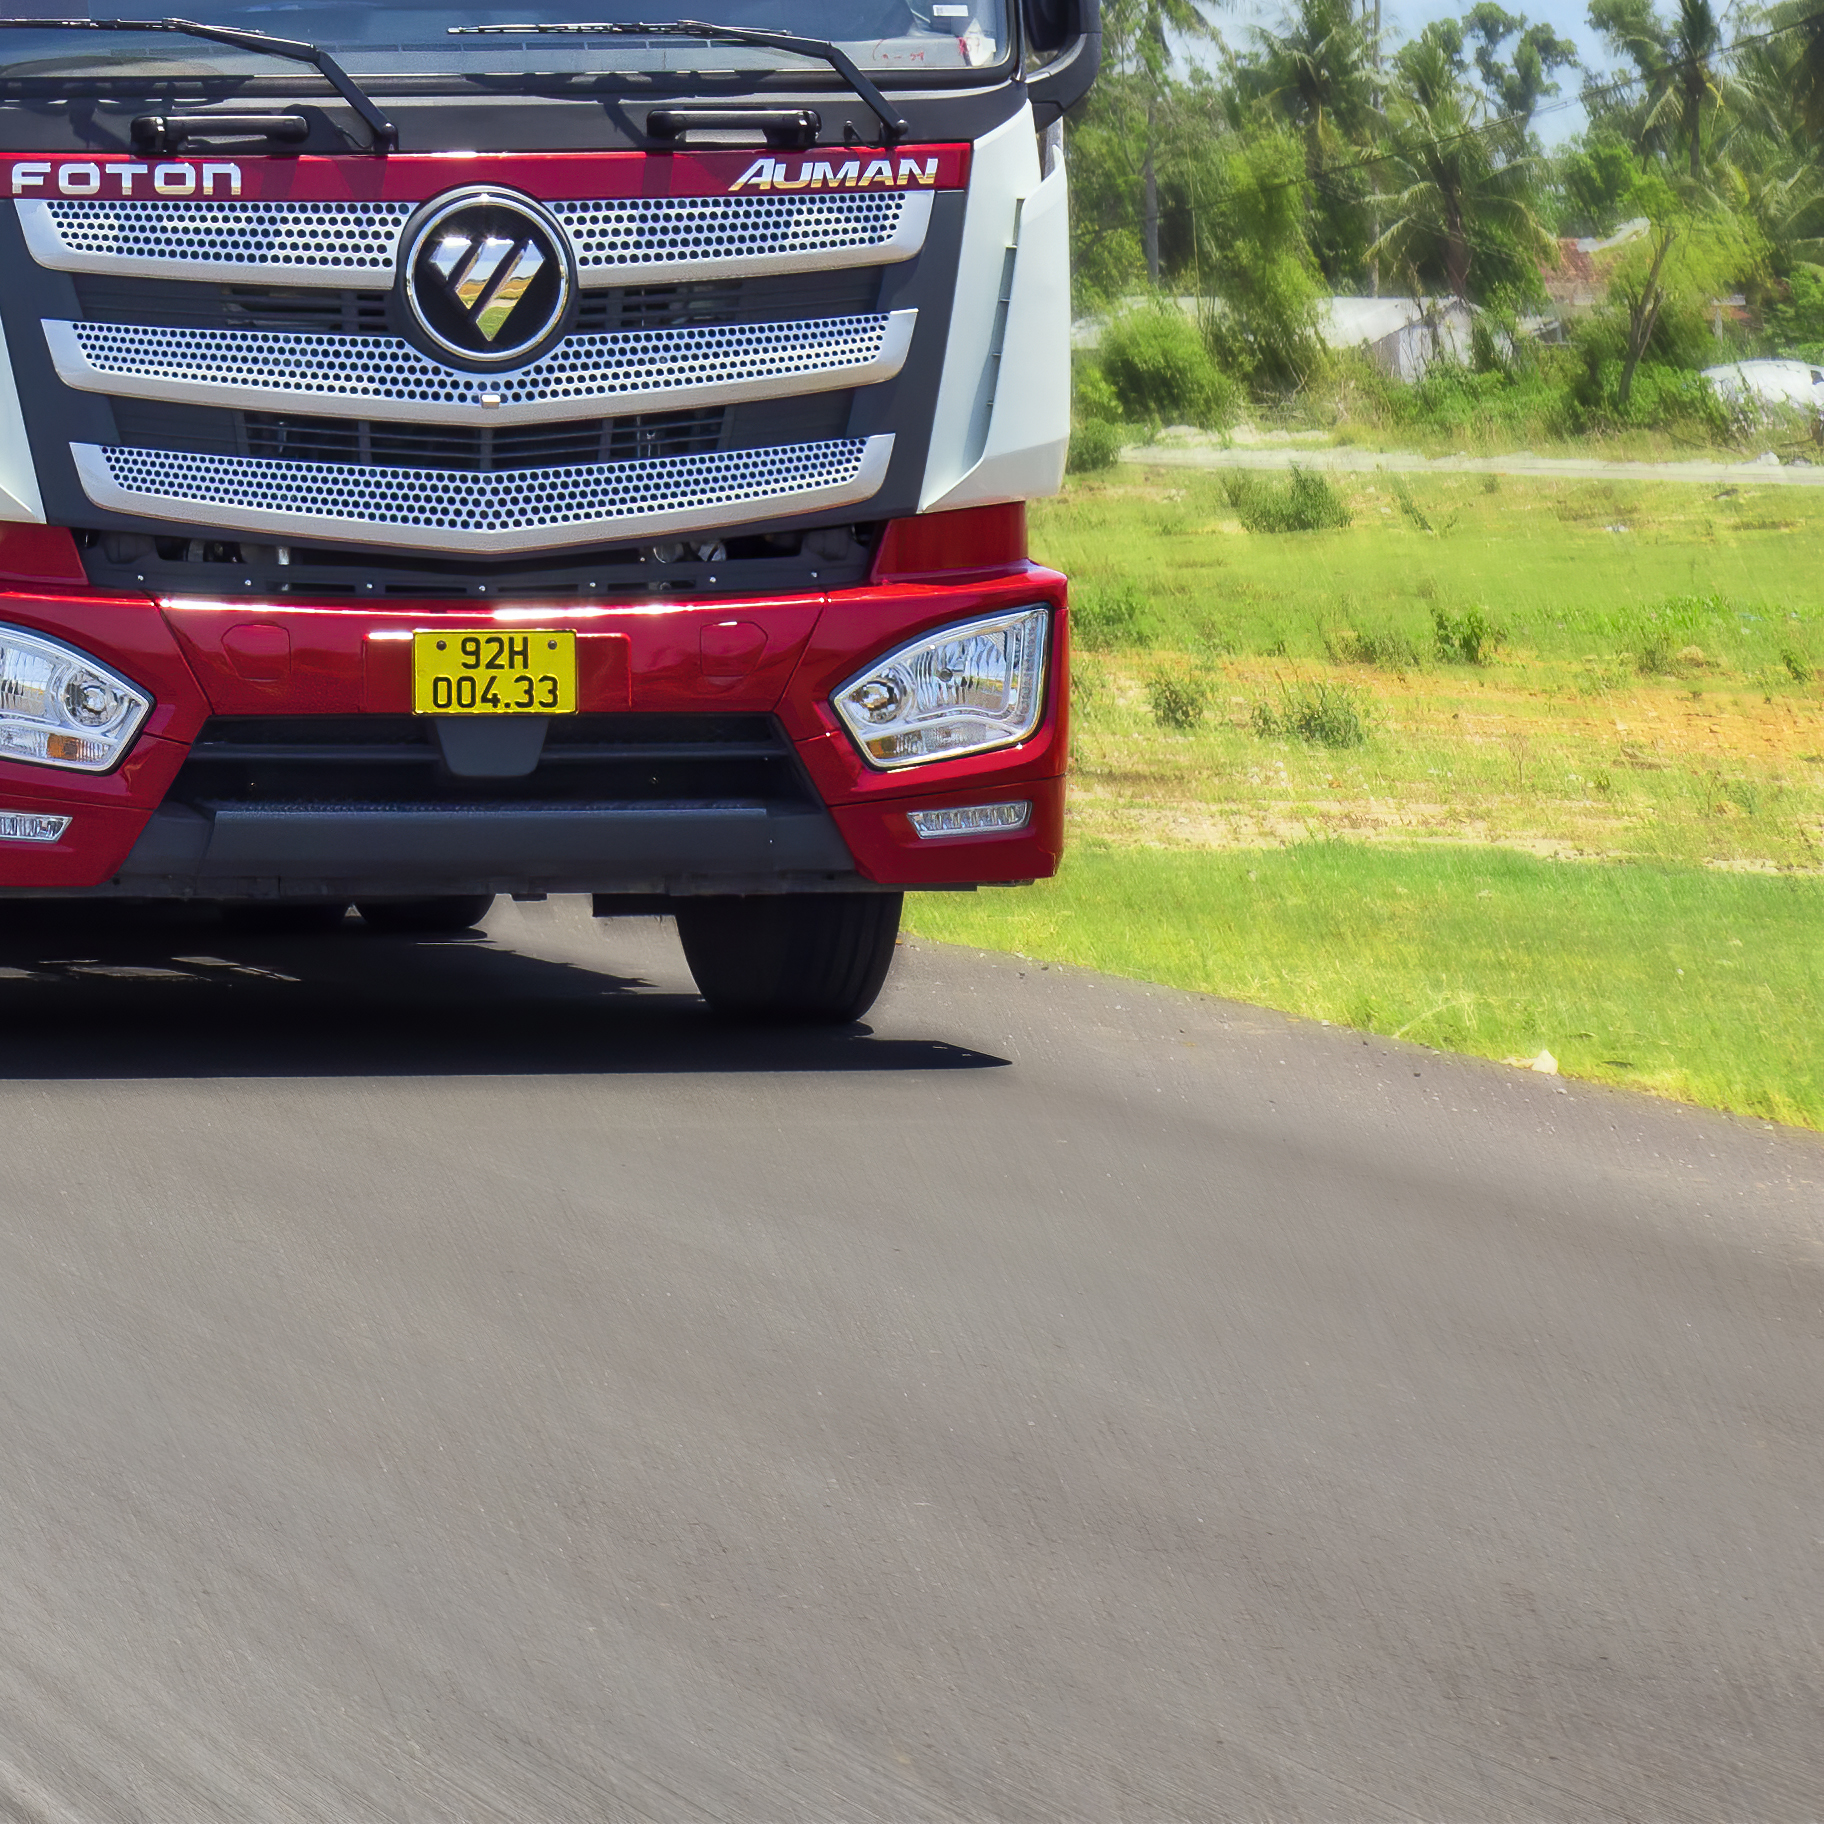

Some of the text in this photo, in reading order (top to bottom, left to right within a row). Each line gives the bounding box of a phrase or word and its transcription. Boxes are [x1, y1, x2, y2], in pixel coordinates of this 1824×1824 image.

[12, 162, 242, 196] FOTON
[727, 158, 939, 191] AUMAN
[461, 636, 529, 669] 92H
[432, 675, 559, 708] 004.33
